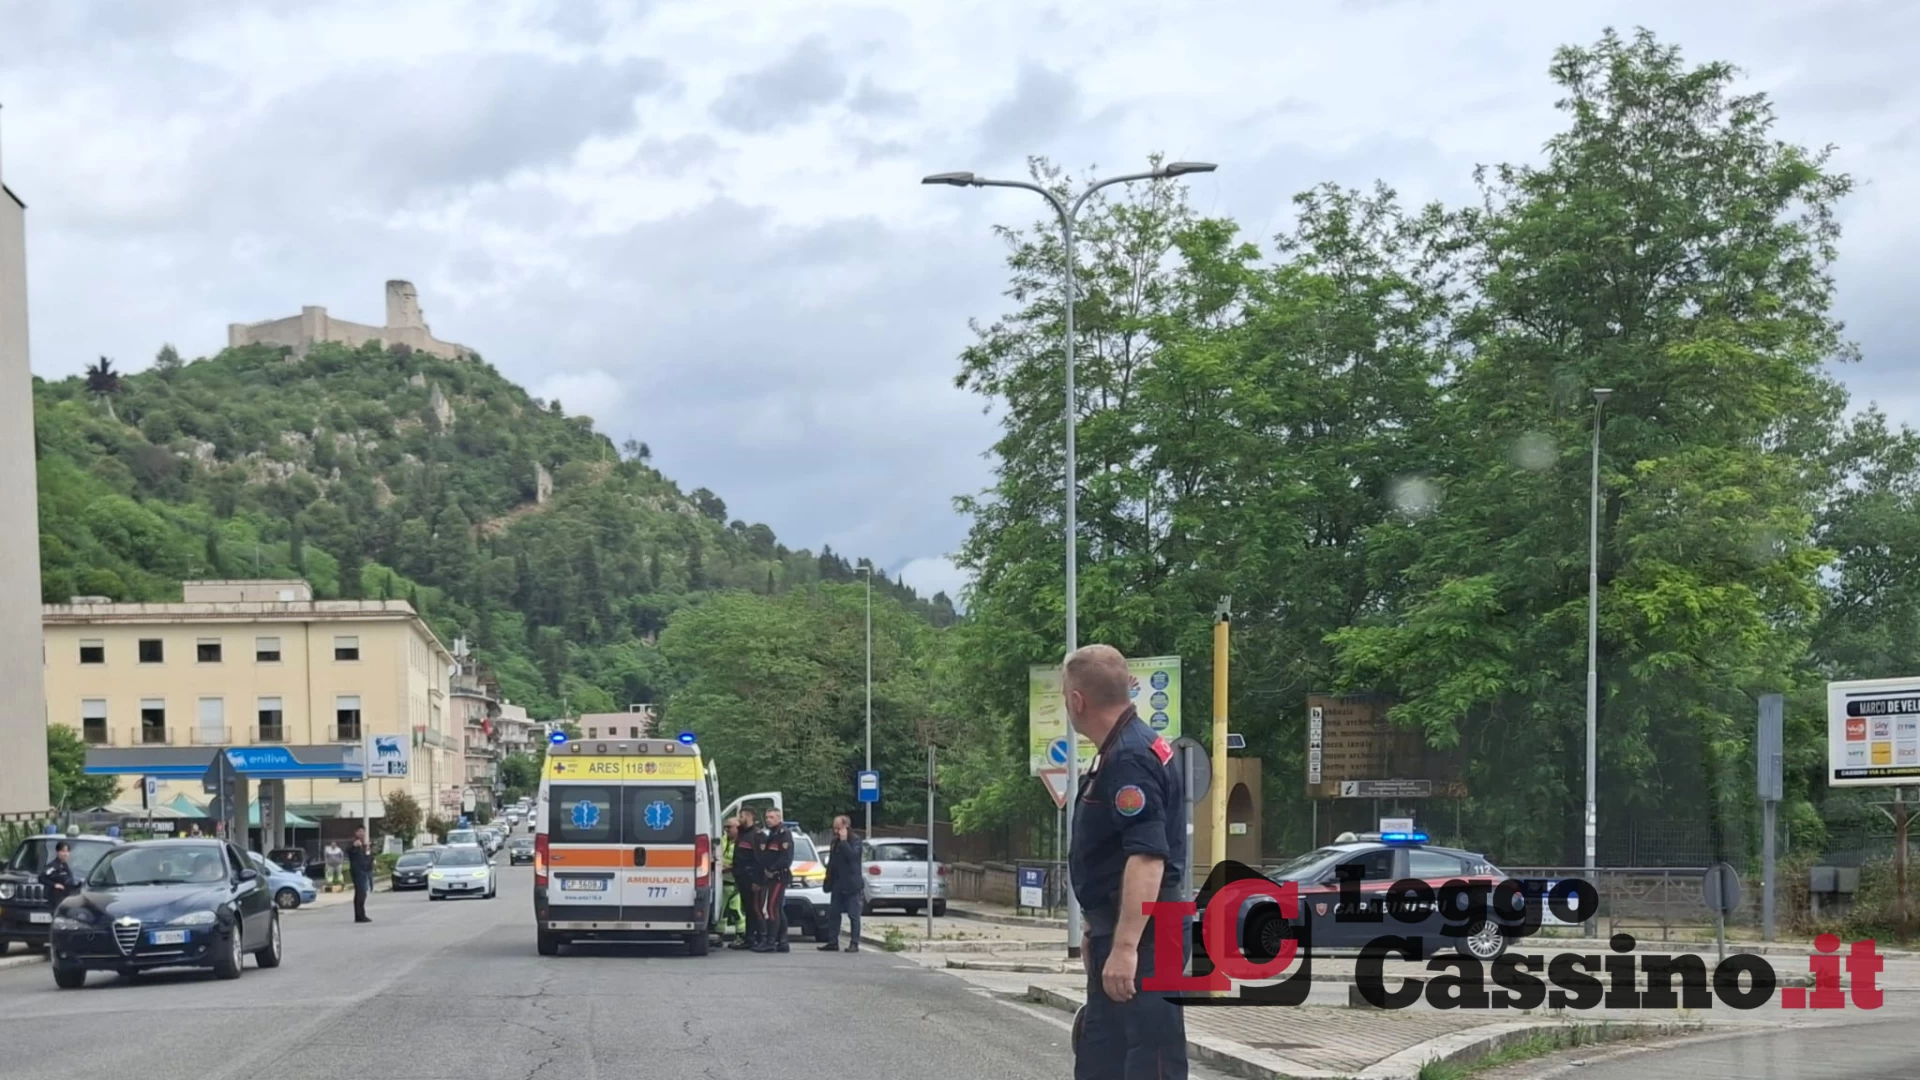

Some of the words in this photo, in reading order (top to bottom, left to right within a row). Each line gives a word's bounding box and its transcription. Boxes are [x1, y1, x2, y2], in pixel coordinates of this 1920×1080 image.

[1860, 701, 1886, 715] MARCO
[1887, 700, 1900, 713] DE
[1901, 698, 1920, 712] VEL
[249, 753, 288, 764] enilive
[588, 762, 620, 774] ARES
[626, 763, 644, 774] 118
[1473, 865, 1492, 875] 112
[626, 876, 690, 884] AMBULANZA
[647, 886, 668, 898] 777
